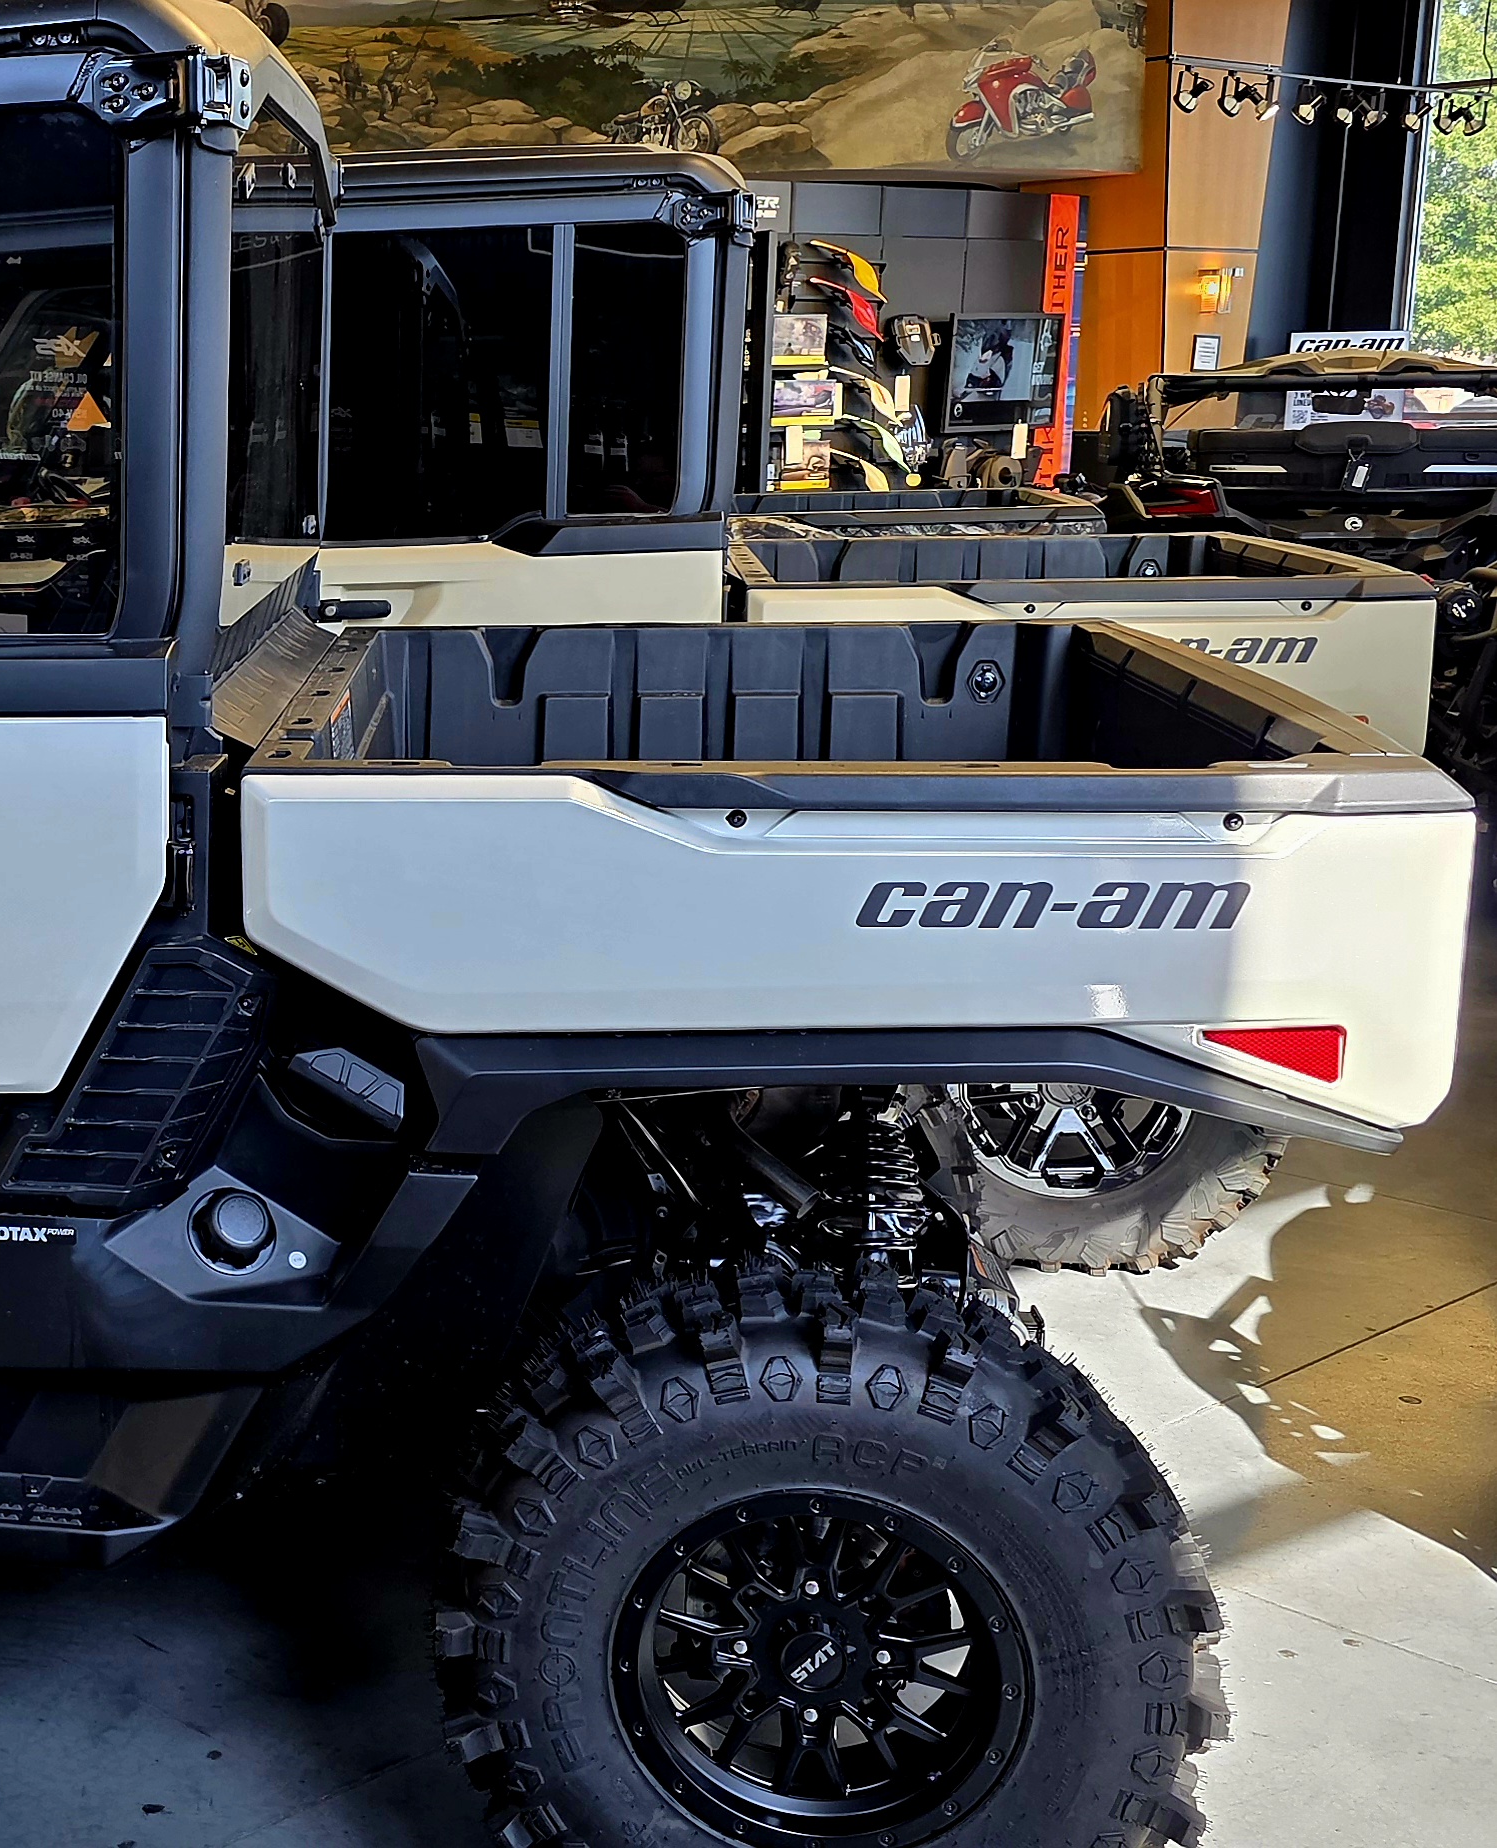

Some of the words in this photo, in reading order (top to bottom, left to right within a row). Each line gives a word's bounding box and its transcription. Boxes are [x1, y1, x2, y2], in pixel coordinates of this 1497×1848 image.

[1295, 336, 1405, 352] can-am
[855, 881, 1252, 929] can-am
[789, 1639, 837, 1685] STAT
